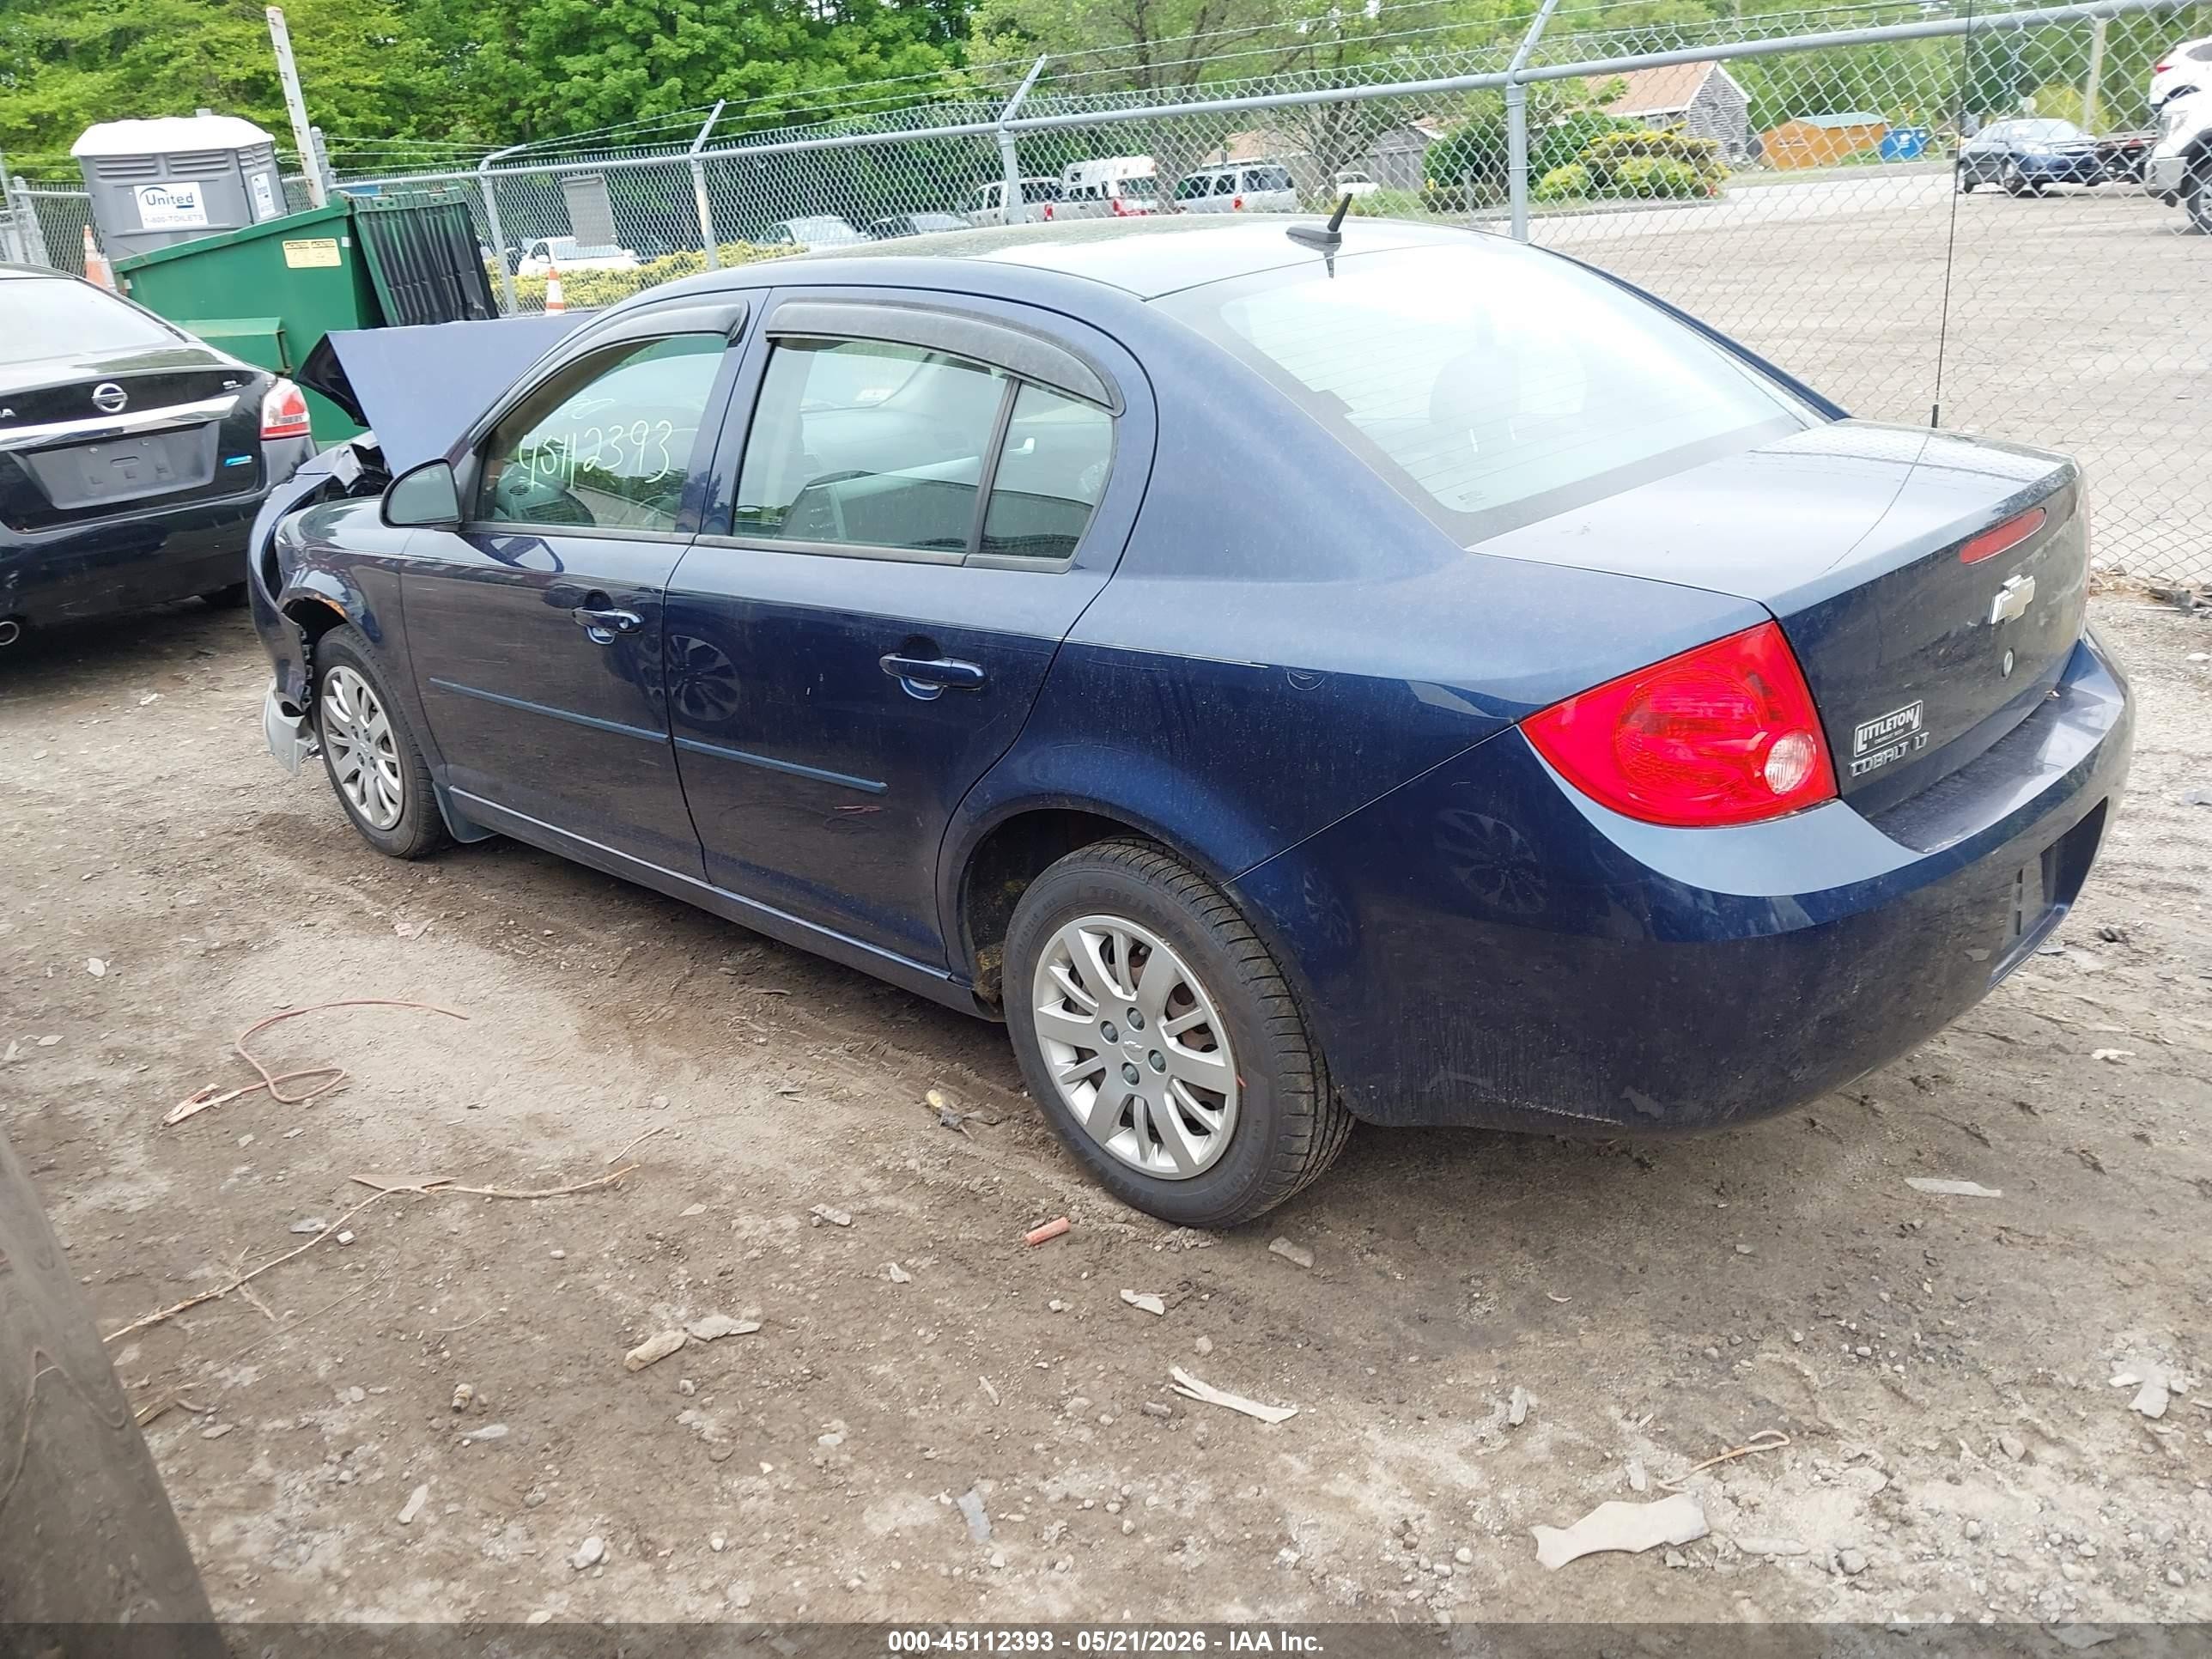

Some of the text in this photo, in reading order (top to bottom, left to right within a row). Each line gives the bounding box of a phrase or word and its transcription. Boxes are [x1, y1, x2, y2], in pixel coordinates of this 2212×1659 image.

[145, 192, 194, 206] United
[519, 419, 672, 493] 45112393
[1856, 708, 1916, 752] LITTLETON
[1850, 741, 1910, 777] COBALT
[1912, 732, 1929, 751] LT
